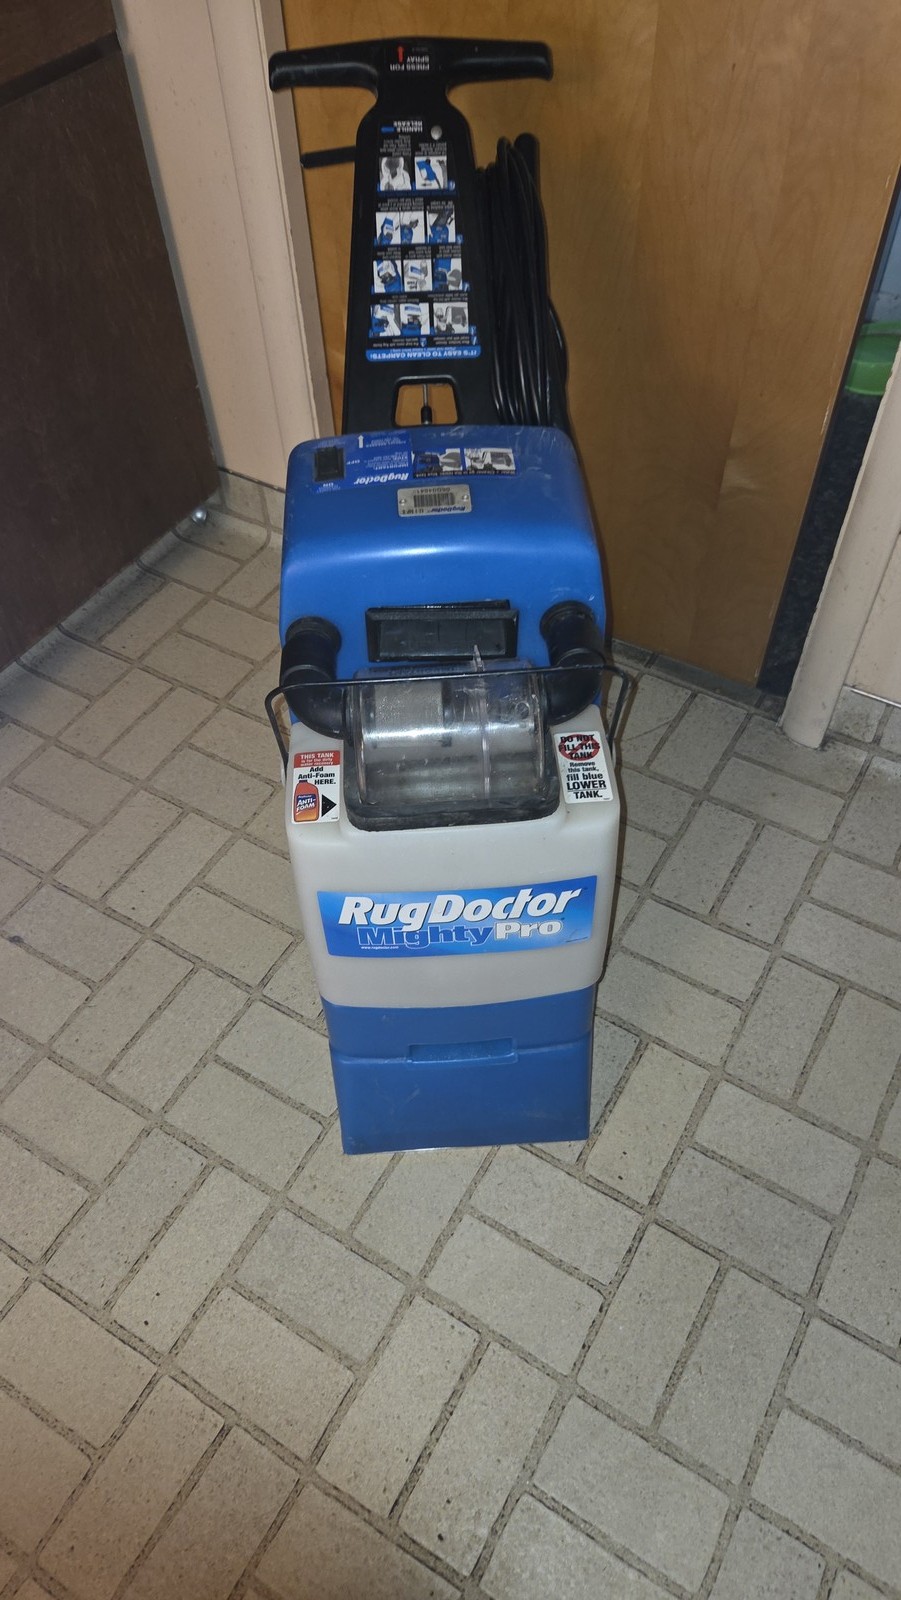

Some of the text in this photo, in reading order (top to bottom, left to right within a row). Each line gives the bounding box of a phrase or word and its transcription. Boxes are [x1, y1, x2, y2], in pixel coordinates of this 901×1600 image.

[406, 55, 430, 63] SPRAY
[353, 472, 410, 485] RugDoctor
[560, 734, 594, 743] DO NOT
[301, 752, 315, 760] THIS
[569, 751, 593, 759] TANK
[298, 772, 335, 780] Anti-Foam
[566, 772, 603, 781] fill blue
[566, 780, 607, 791] LOWER
[573, 790, 603, 799] TANK.
[297, 797, 317, 807] ANTI-
[296, 802, 315, 813] FOAM
[338, 888, 584, 932] RugDoctor
[356, 920, 564, 950] Mighty Pro
